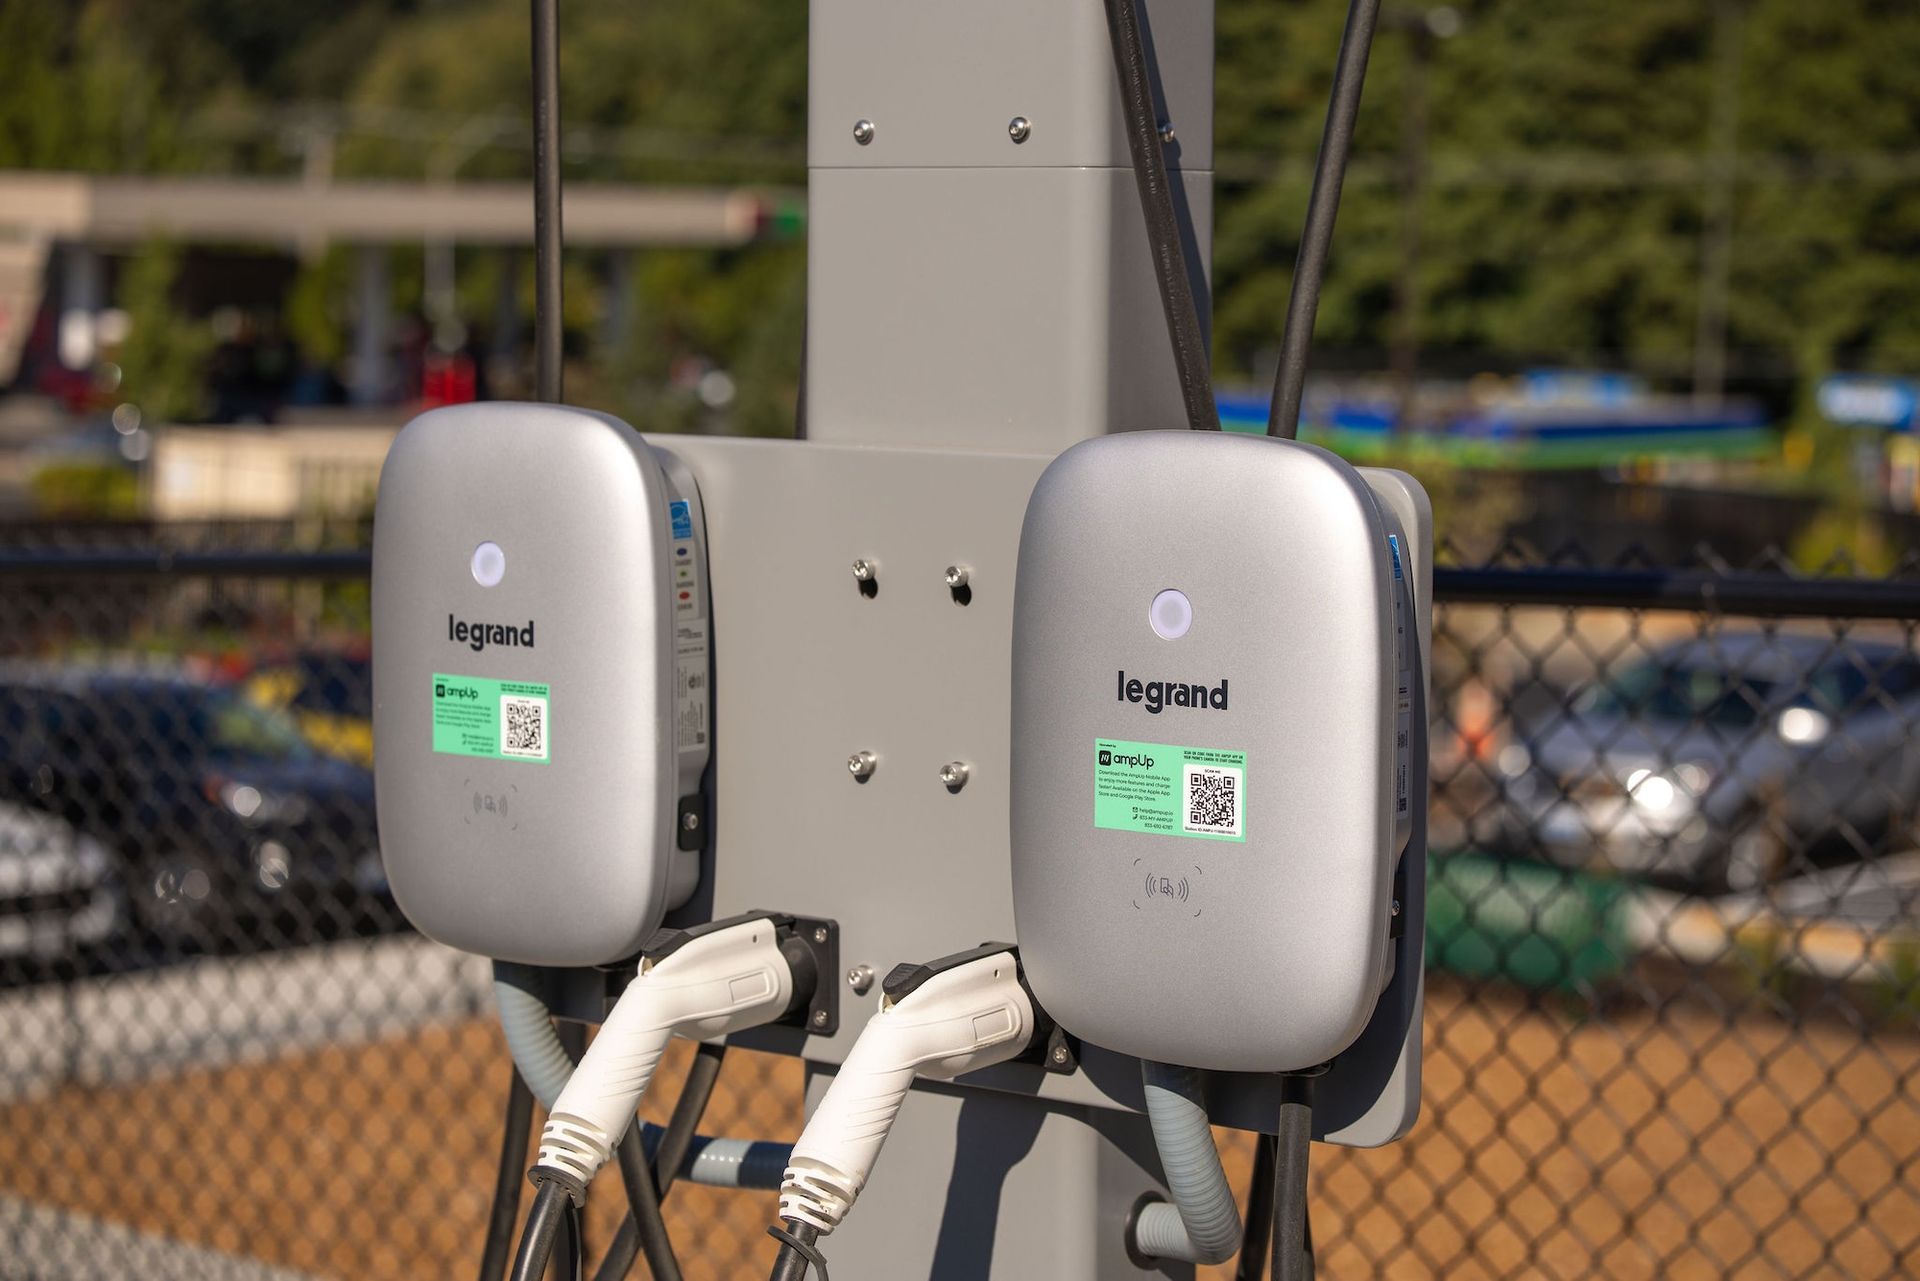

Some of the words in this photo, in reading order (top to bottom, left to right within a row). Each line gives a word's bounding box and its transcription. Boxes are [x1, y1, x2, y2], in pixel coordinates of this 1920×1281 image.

[449, 613, 534, 652] legrand
[446, 686, 479, 701] ampUp
[1117, 670, 1229, 714] legrand
[1113, 754, 1154, 770] ampUp
